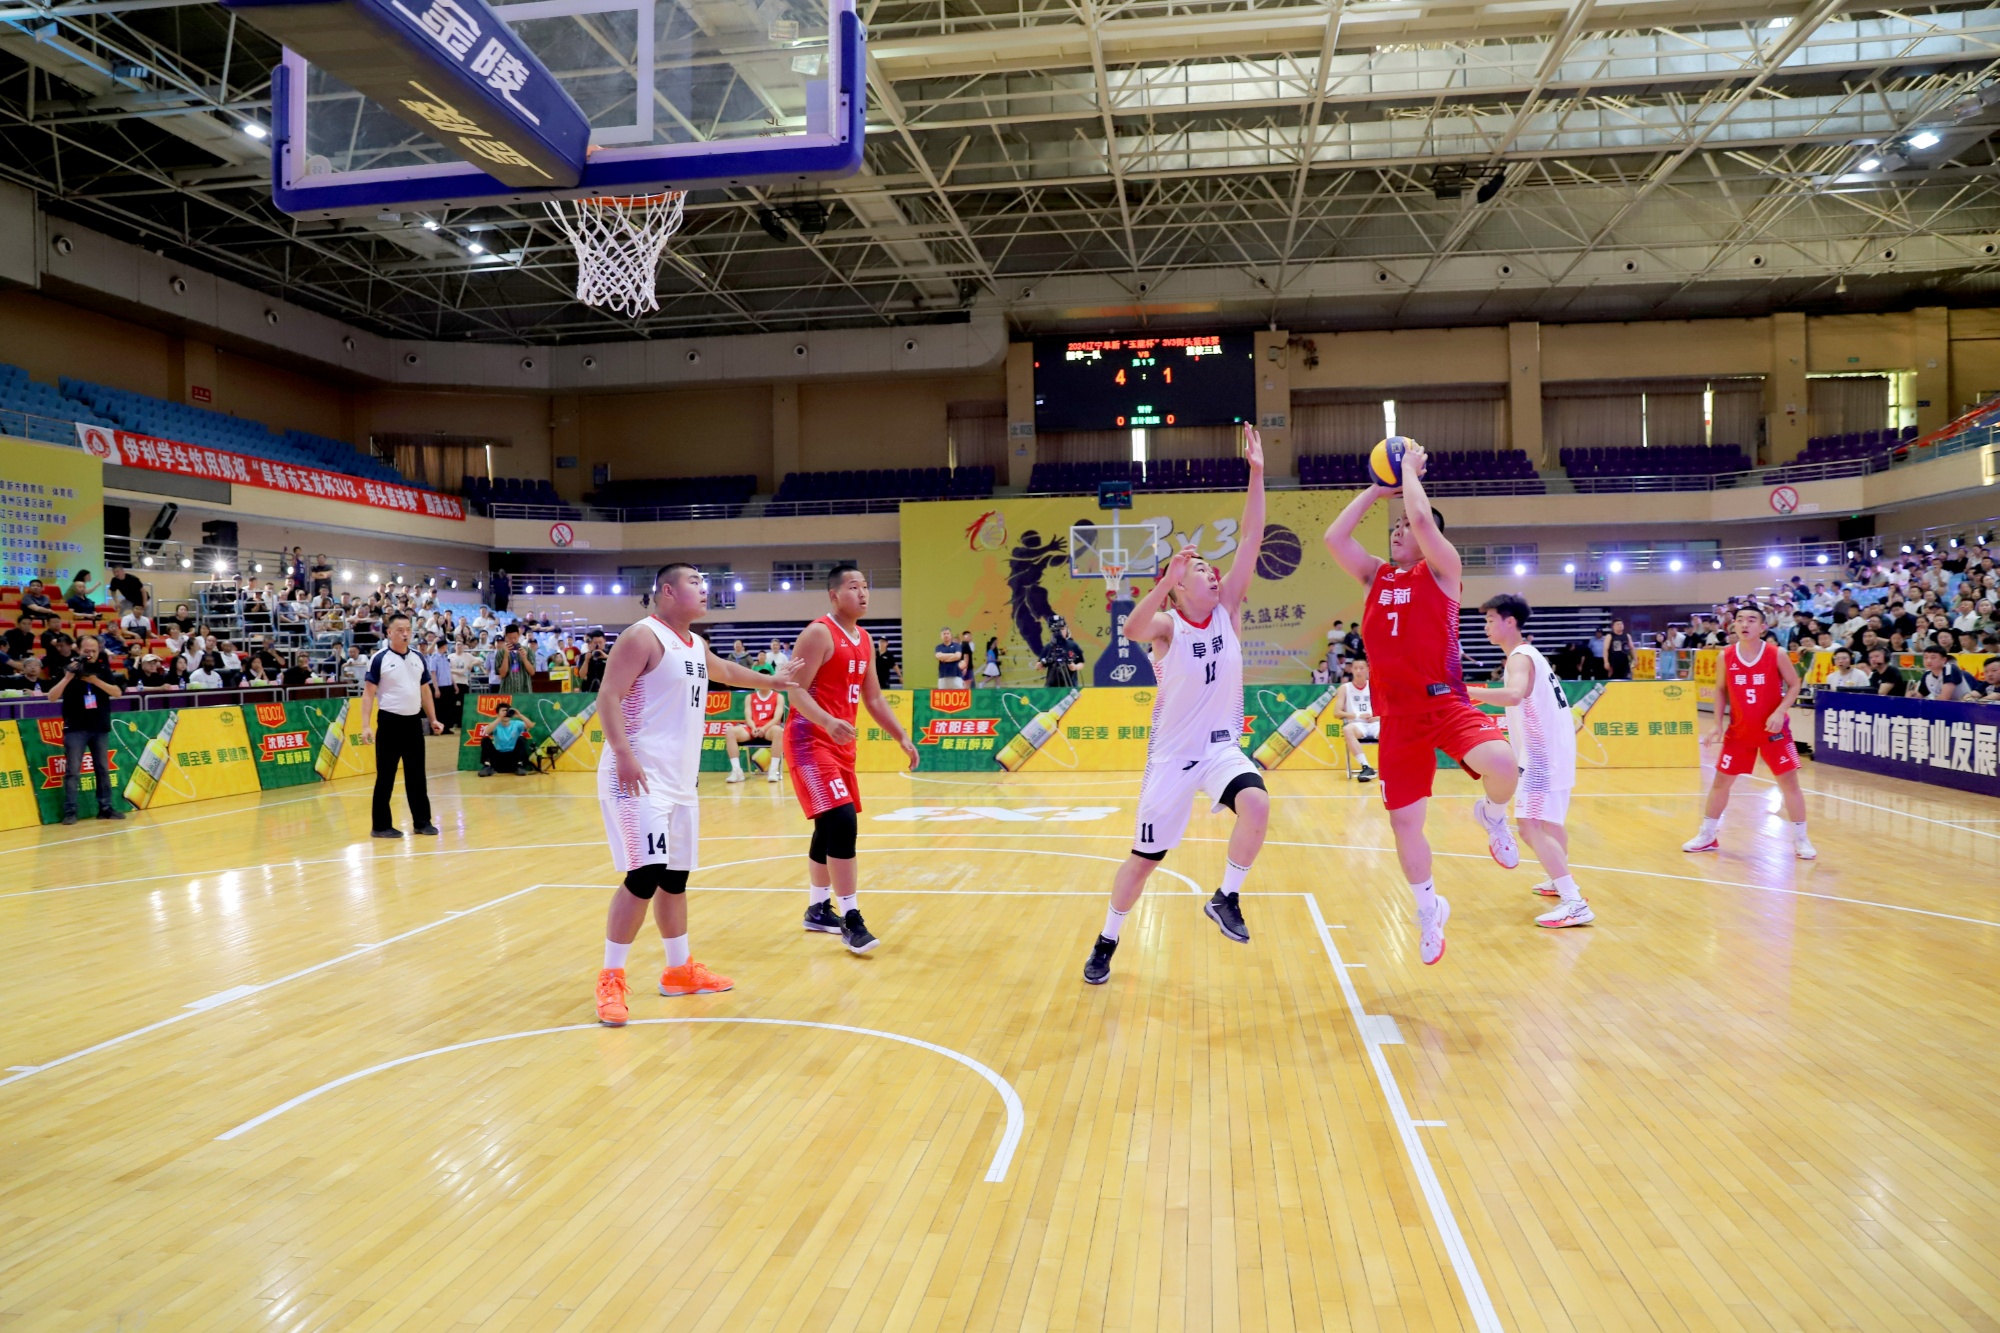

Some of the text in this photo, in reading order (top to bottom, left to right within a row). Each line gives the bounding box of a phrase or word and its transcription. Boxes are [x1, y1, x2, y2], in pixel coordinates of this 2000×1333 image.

[392, 0, 541, 126] 金陵
[1115, 369, 1126, 385] 4
[1163, 367, 1172, 383] 1
[1116, 416, 1125, 426] 0
[1166, 414, 1175, 424] 0
[1377, 587, 1411, 606] 阜新
[1387, 612, 1399, 637] 7
[1192, 635, 1224, 659] 阜新
[684, 660, 707, 679] 阜新
[848, 660, 867, 675] 阜新
[1204, 660, 1217, 685] 11
[1734, 673, 1766, 685] 阜新
[690, 685, 701, 708] 14
[706, 694, 728, 709] 00%
[848, 684, 860, 704] 15
[940, 691, 968, 707] 100%
[1745, 688, 1757, 704] 5
[935, 720, 990, 734] 沈阳全麦
[1066, 726, 1109, 740] 喝全麦
[1593, 720, 1694, 736] 喝全麦 更健康
[267, 733, 305, 750] 沈阳全麦
[1822, 707, 2000, 778] 阜新市体育事业发展
[177, 746, 250, 767] 喝全麦 更健康
[1720, 754, 1732, 770] 5
[829, 778, 849, 800] 15
[1140, 822, 1155, 843] 11
[647, 832, 667, 855] 14
